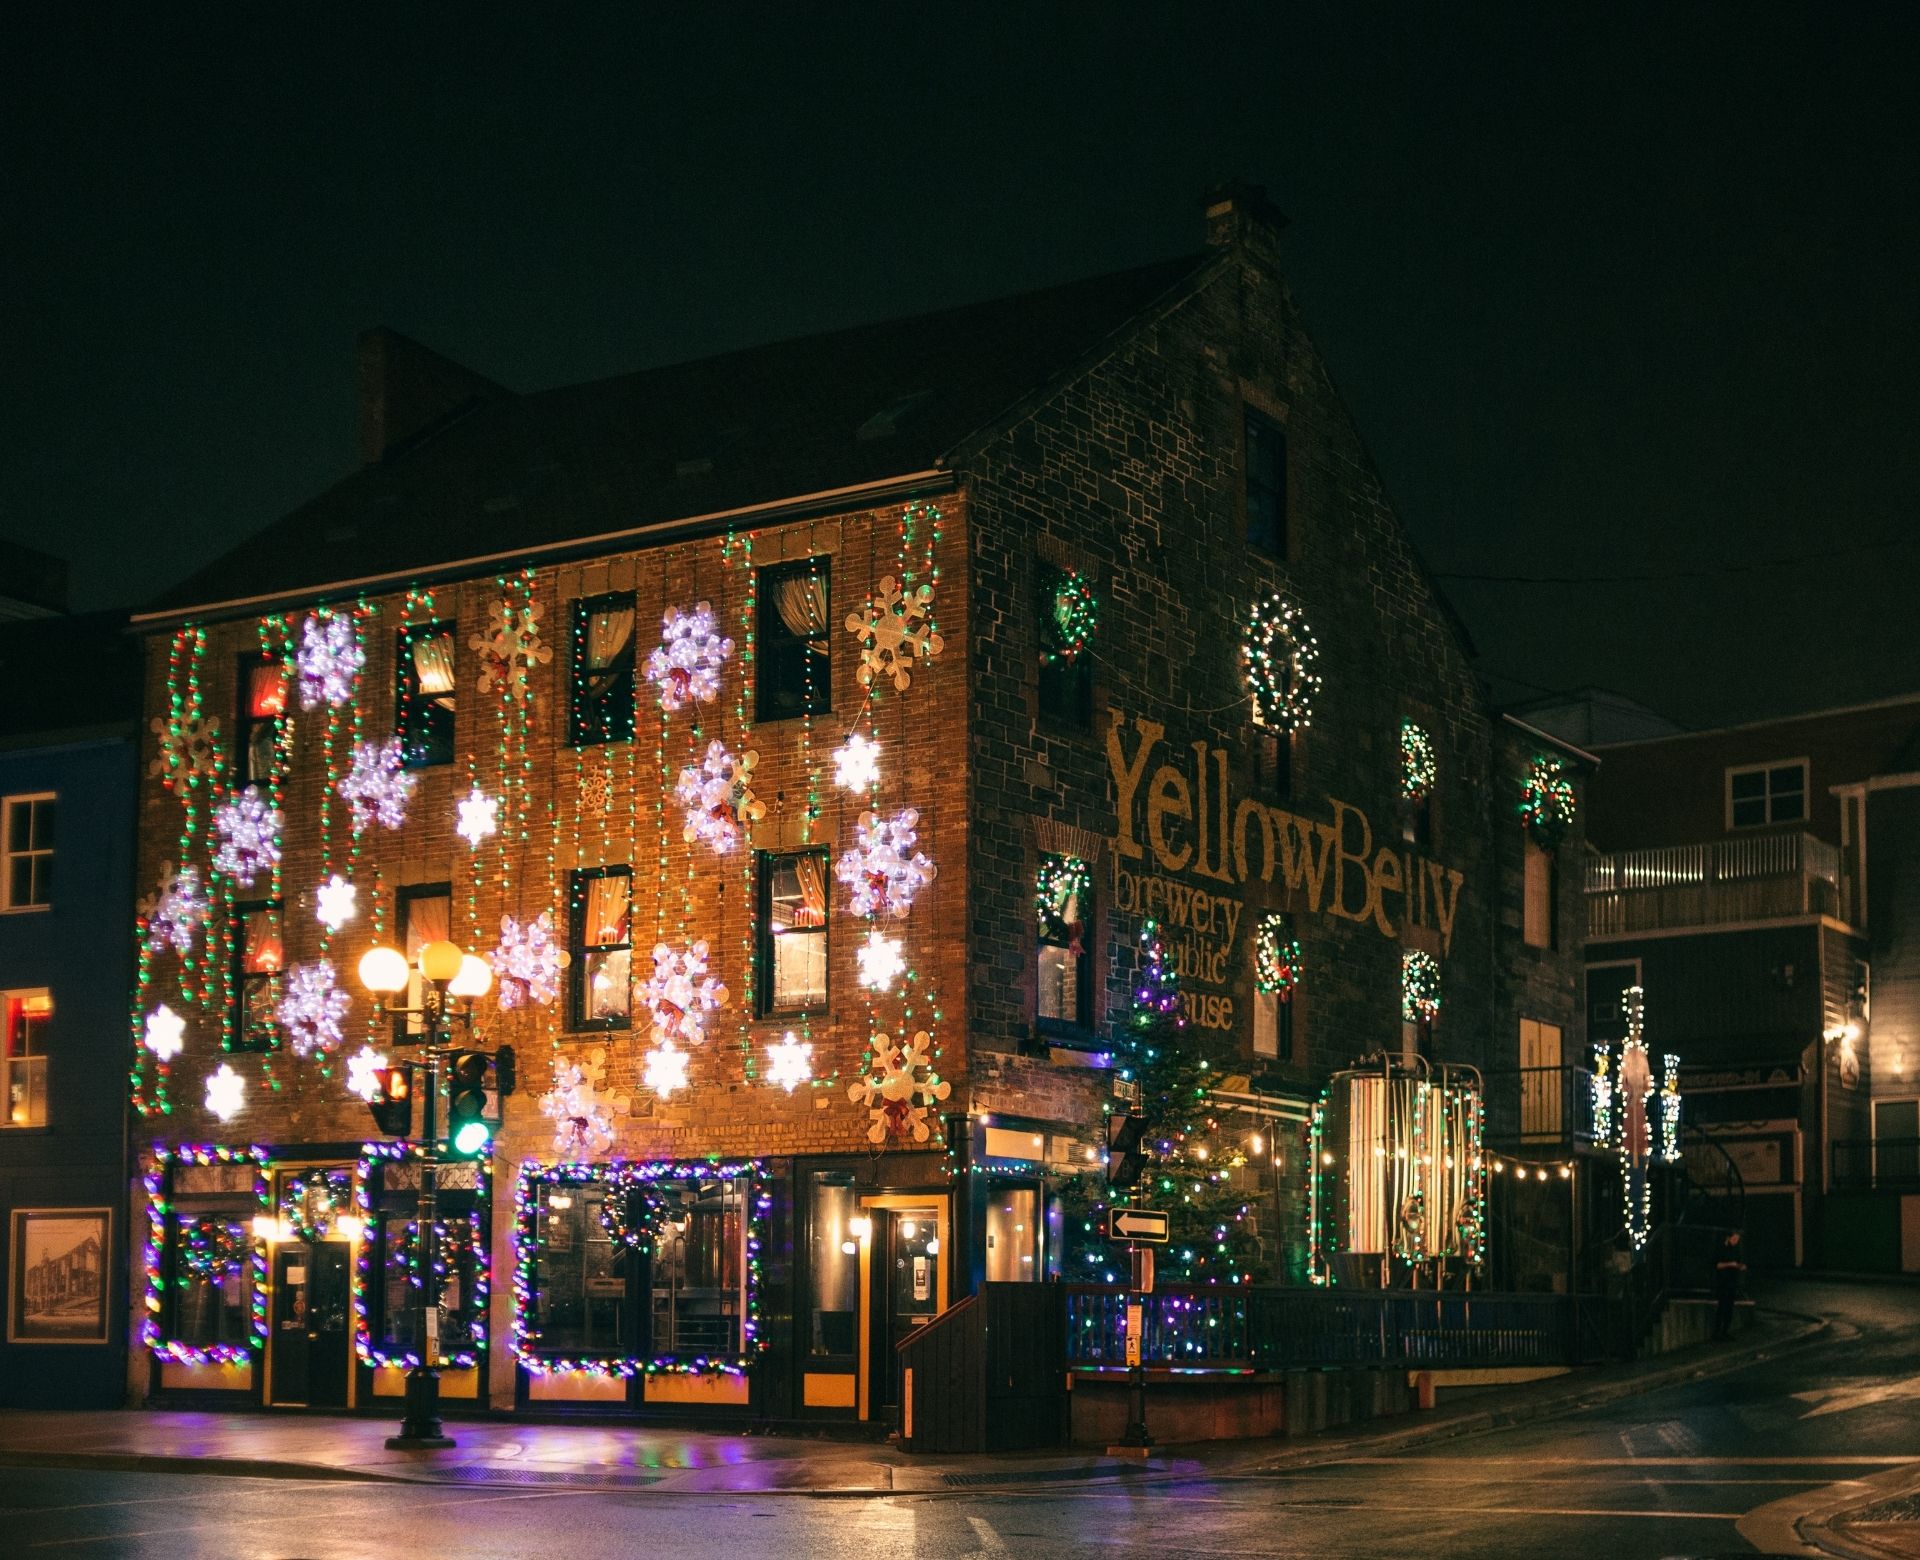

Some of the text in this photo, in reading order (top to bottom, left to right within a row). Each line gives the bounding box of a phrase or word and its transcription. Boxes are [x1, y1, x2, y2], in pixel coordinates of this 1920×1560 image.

[1106, 706, 1464, 958] YellowBelly
[1113, 851, 1243, 955] brewery
[1162, 933, 1226, 984] ublic
